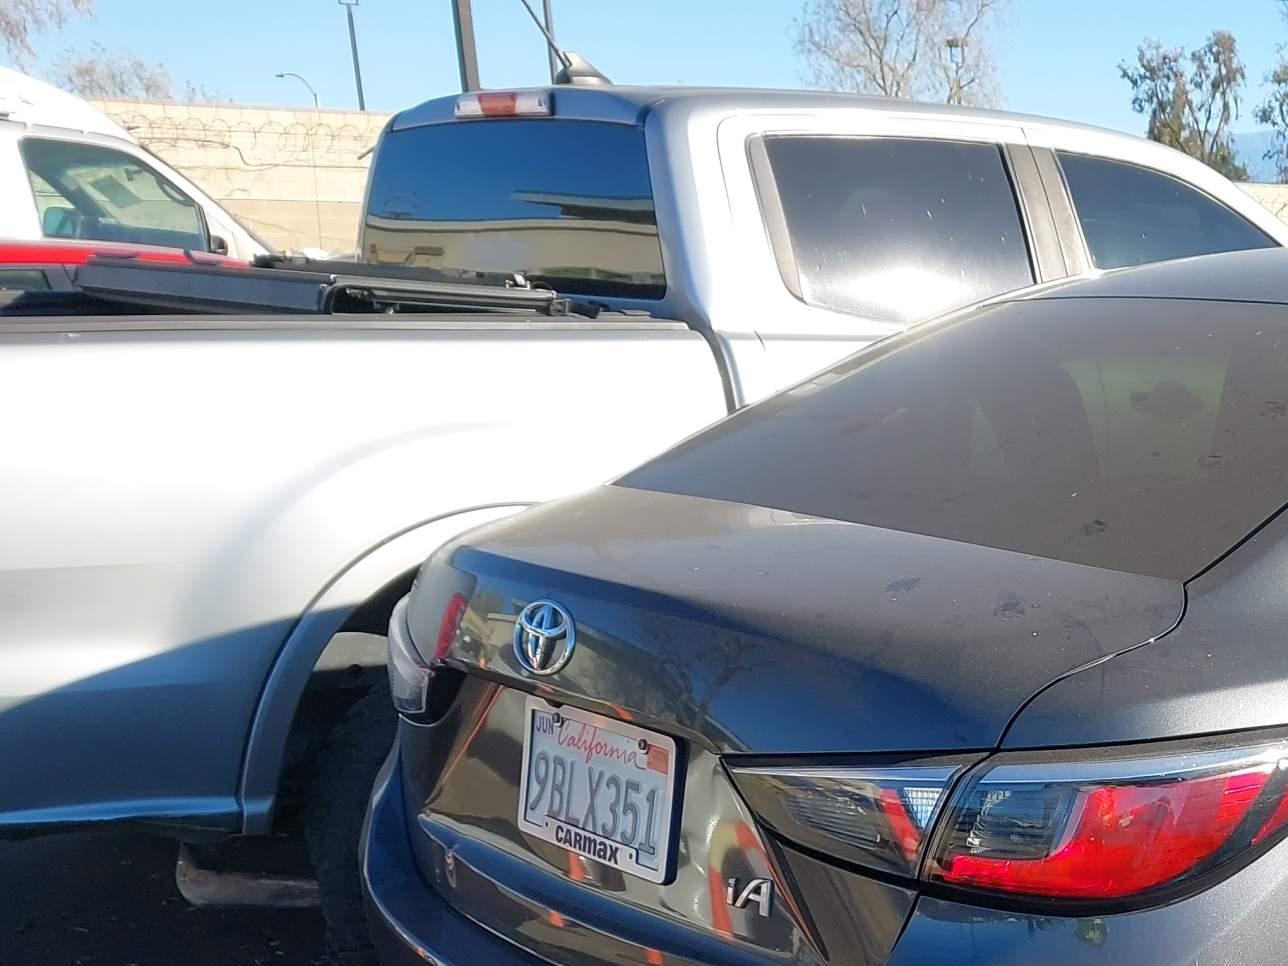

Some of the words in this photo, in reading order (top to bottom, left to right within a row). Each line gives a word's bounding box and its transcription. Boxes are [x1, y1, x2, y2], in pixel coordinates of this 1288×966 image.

[536, 715, 553, 735] JUN
[557, 718, 647, 770] California
[529, 752, 656, 856] 9BLX351
